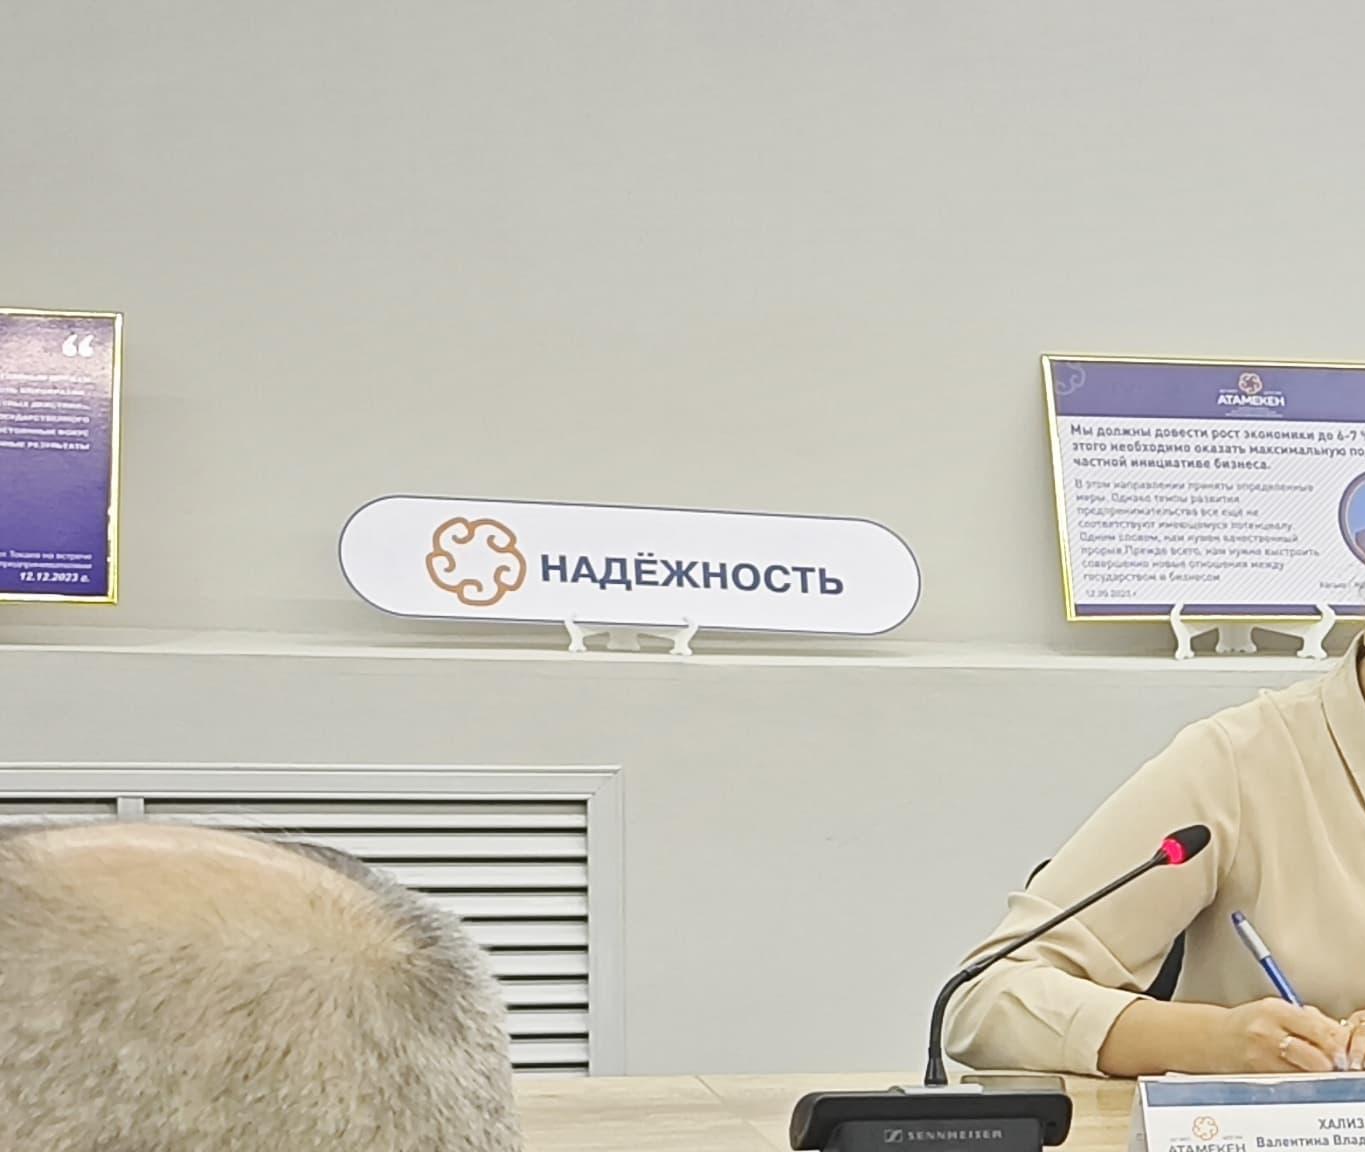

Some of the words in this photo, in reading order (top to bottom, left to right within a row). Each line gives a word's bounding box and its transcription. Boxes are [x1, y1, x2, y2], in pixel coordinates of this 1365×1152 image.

[1070, 424, 1093, 436] Мы
[1096, 426, 1151, 438] должны
[1154, 427, 1209, 439] довести
[1211, 429, 1241, 440] рост
[1243, 430, 1315, 441] экономики
[1318, 431, 1334, 442] до
[1072, 440, 1108, 452] этого
[1110, 441, 1191, 454] необходимо
[1194, 444, 1246, 455] оказать
[1249, 445, 1347, 458] максимальную
[1073, 456, 1128, 468] частной
[1130, 458, 1211, 470] инициативе
[1214, 457, 1271, 471] бизнеса.
[540, 551, 845, 597] НАДЁЖНОСТЬ
[906, 1129, 1004, 1141] SENNHEISER
[1256, 1135, 1331, 1149] Валентина
